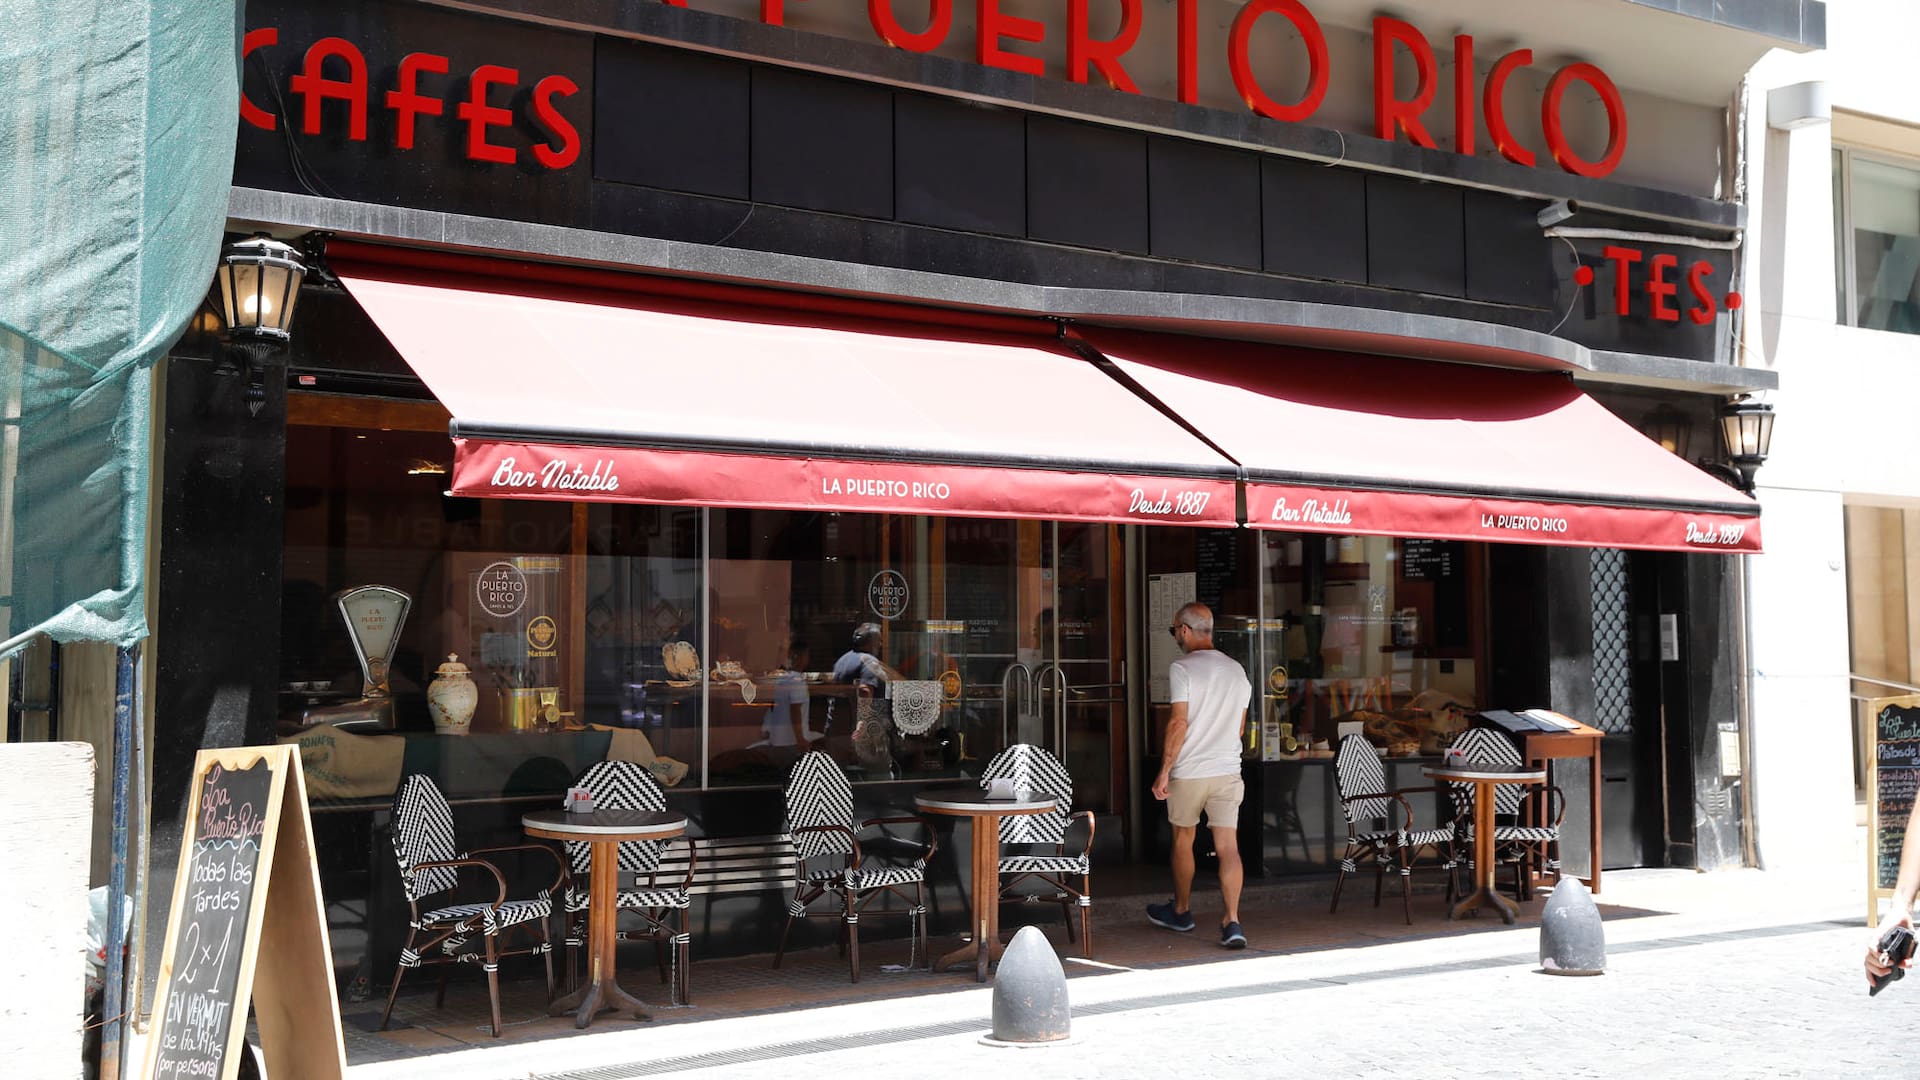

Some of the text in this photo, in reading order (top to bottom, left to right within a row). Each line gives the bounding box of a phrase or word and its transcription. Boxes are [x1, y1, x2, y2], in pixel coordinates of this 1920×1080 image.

[242, 28, 581, 169] CAFES
[760, 0, 1628, 179] ERTO RICO
[1603, 245, 1717, 325] TES
[491, 457, 619, 491] Bar Notable
[822, 477, 950, 499] LA PUERTO RICO
[1128, 488, 1211, 516] Desde 1887
[1271, 497, 1352, 525] Bar Notable
[1481, 514, 1567, 533] LA PUERTO RICO
[1685, 521, 1746, 545] Desde 1887
[482, 581, 523, 592] PUERTO
[496, 570, 509, 580] LA
[883, 577, 894, 586] LA
[489, 592, 515, 602] RICO
[872, 586, 906, 597] PUERTO
[879, 597, 899, 605] RICO
[199, 805, 239, 840] Puerto
[192, 848, 253, 885] Todas las
[166, 991, 229, 1040] EN VERMUT
[163, 1030, 177, 1050] de
